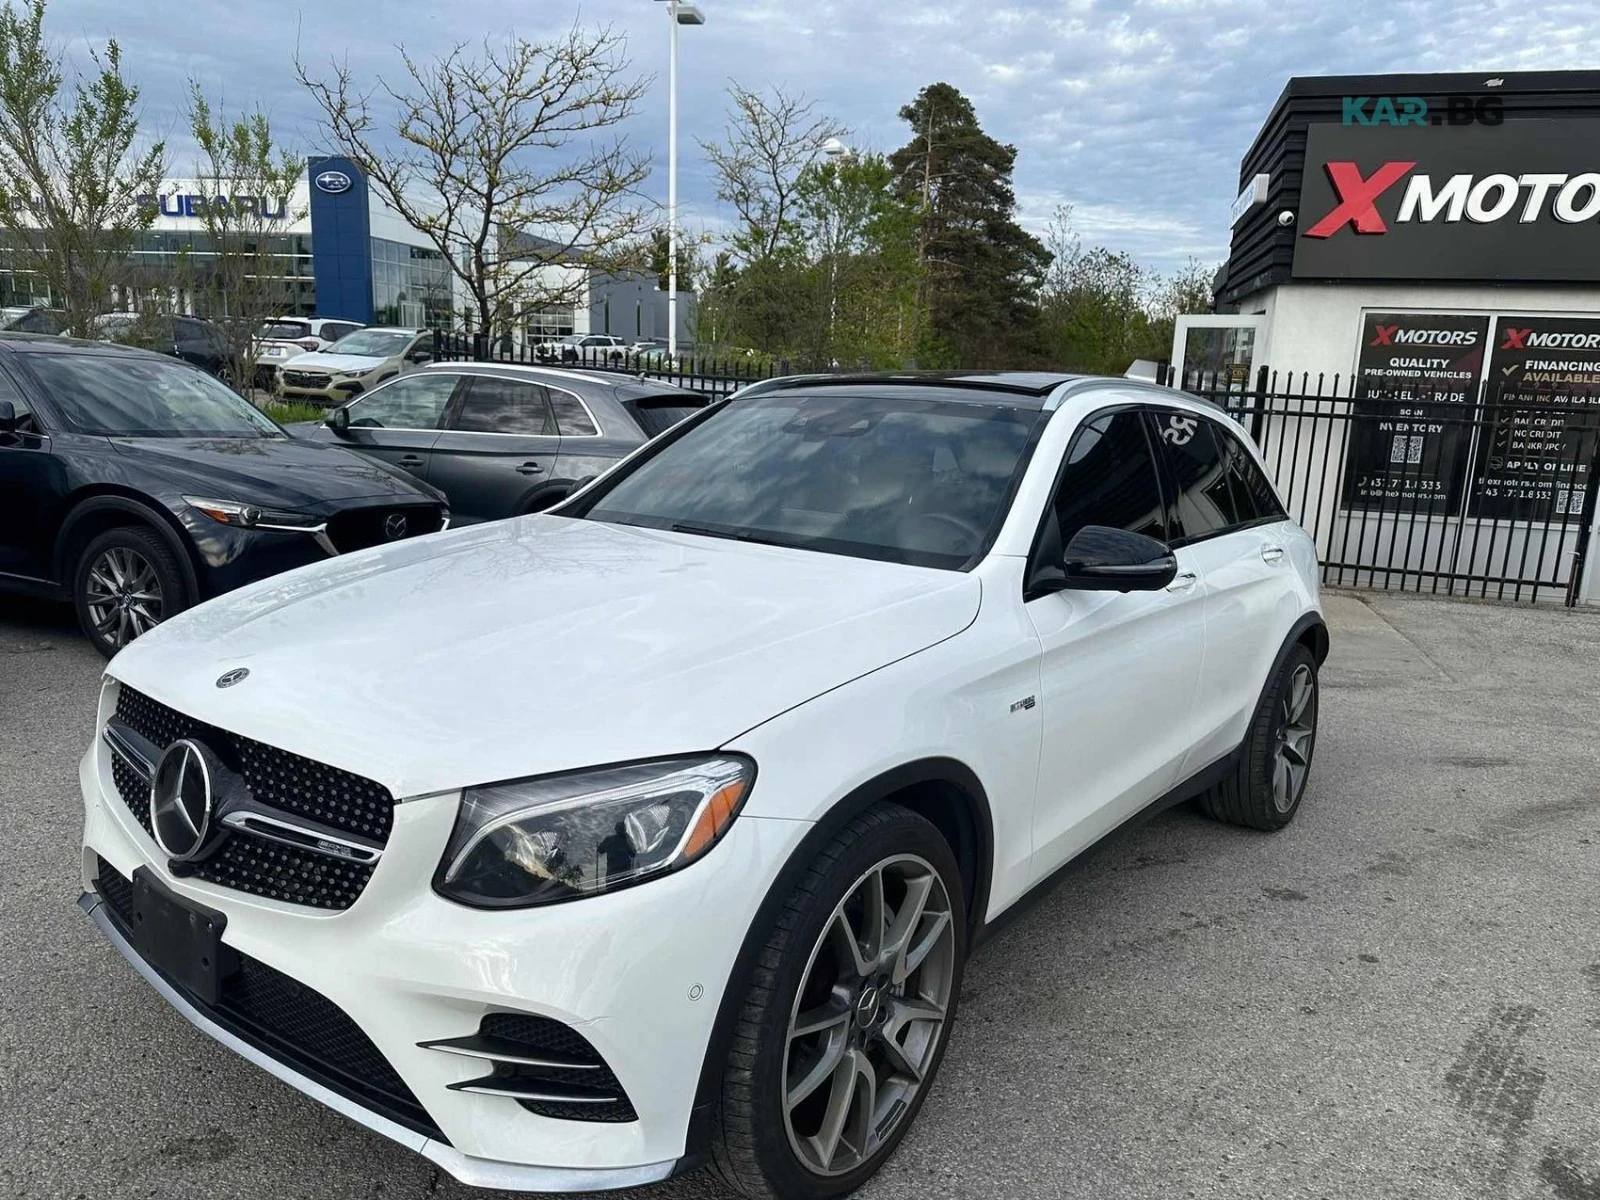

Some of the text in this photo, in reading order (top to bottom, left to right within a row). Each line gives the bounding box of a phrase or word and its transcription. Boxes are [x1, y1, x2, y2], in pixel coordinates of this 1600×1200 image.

[1389, 357, 1450, 369] QUALITY
[1525, 360, 1600, 372] FINANCING
[1364, 368, 1472, 379] PRE-OWNED VEHICLES
[1523, 372, 1600, 384] AVAILABLE
[1428, 391, 1465, 402] RADE
[1503, 393, 1551, 402] FINANING
[1379, 422, 1443, 433] NENTORY
